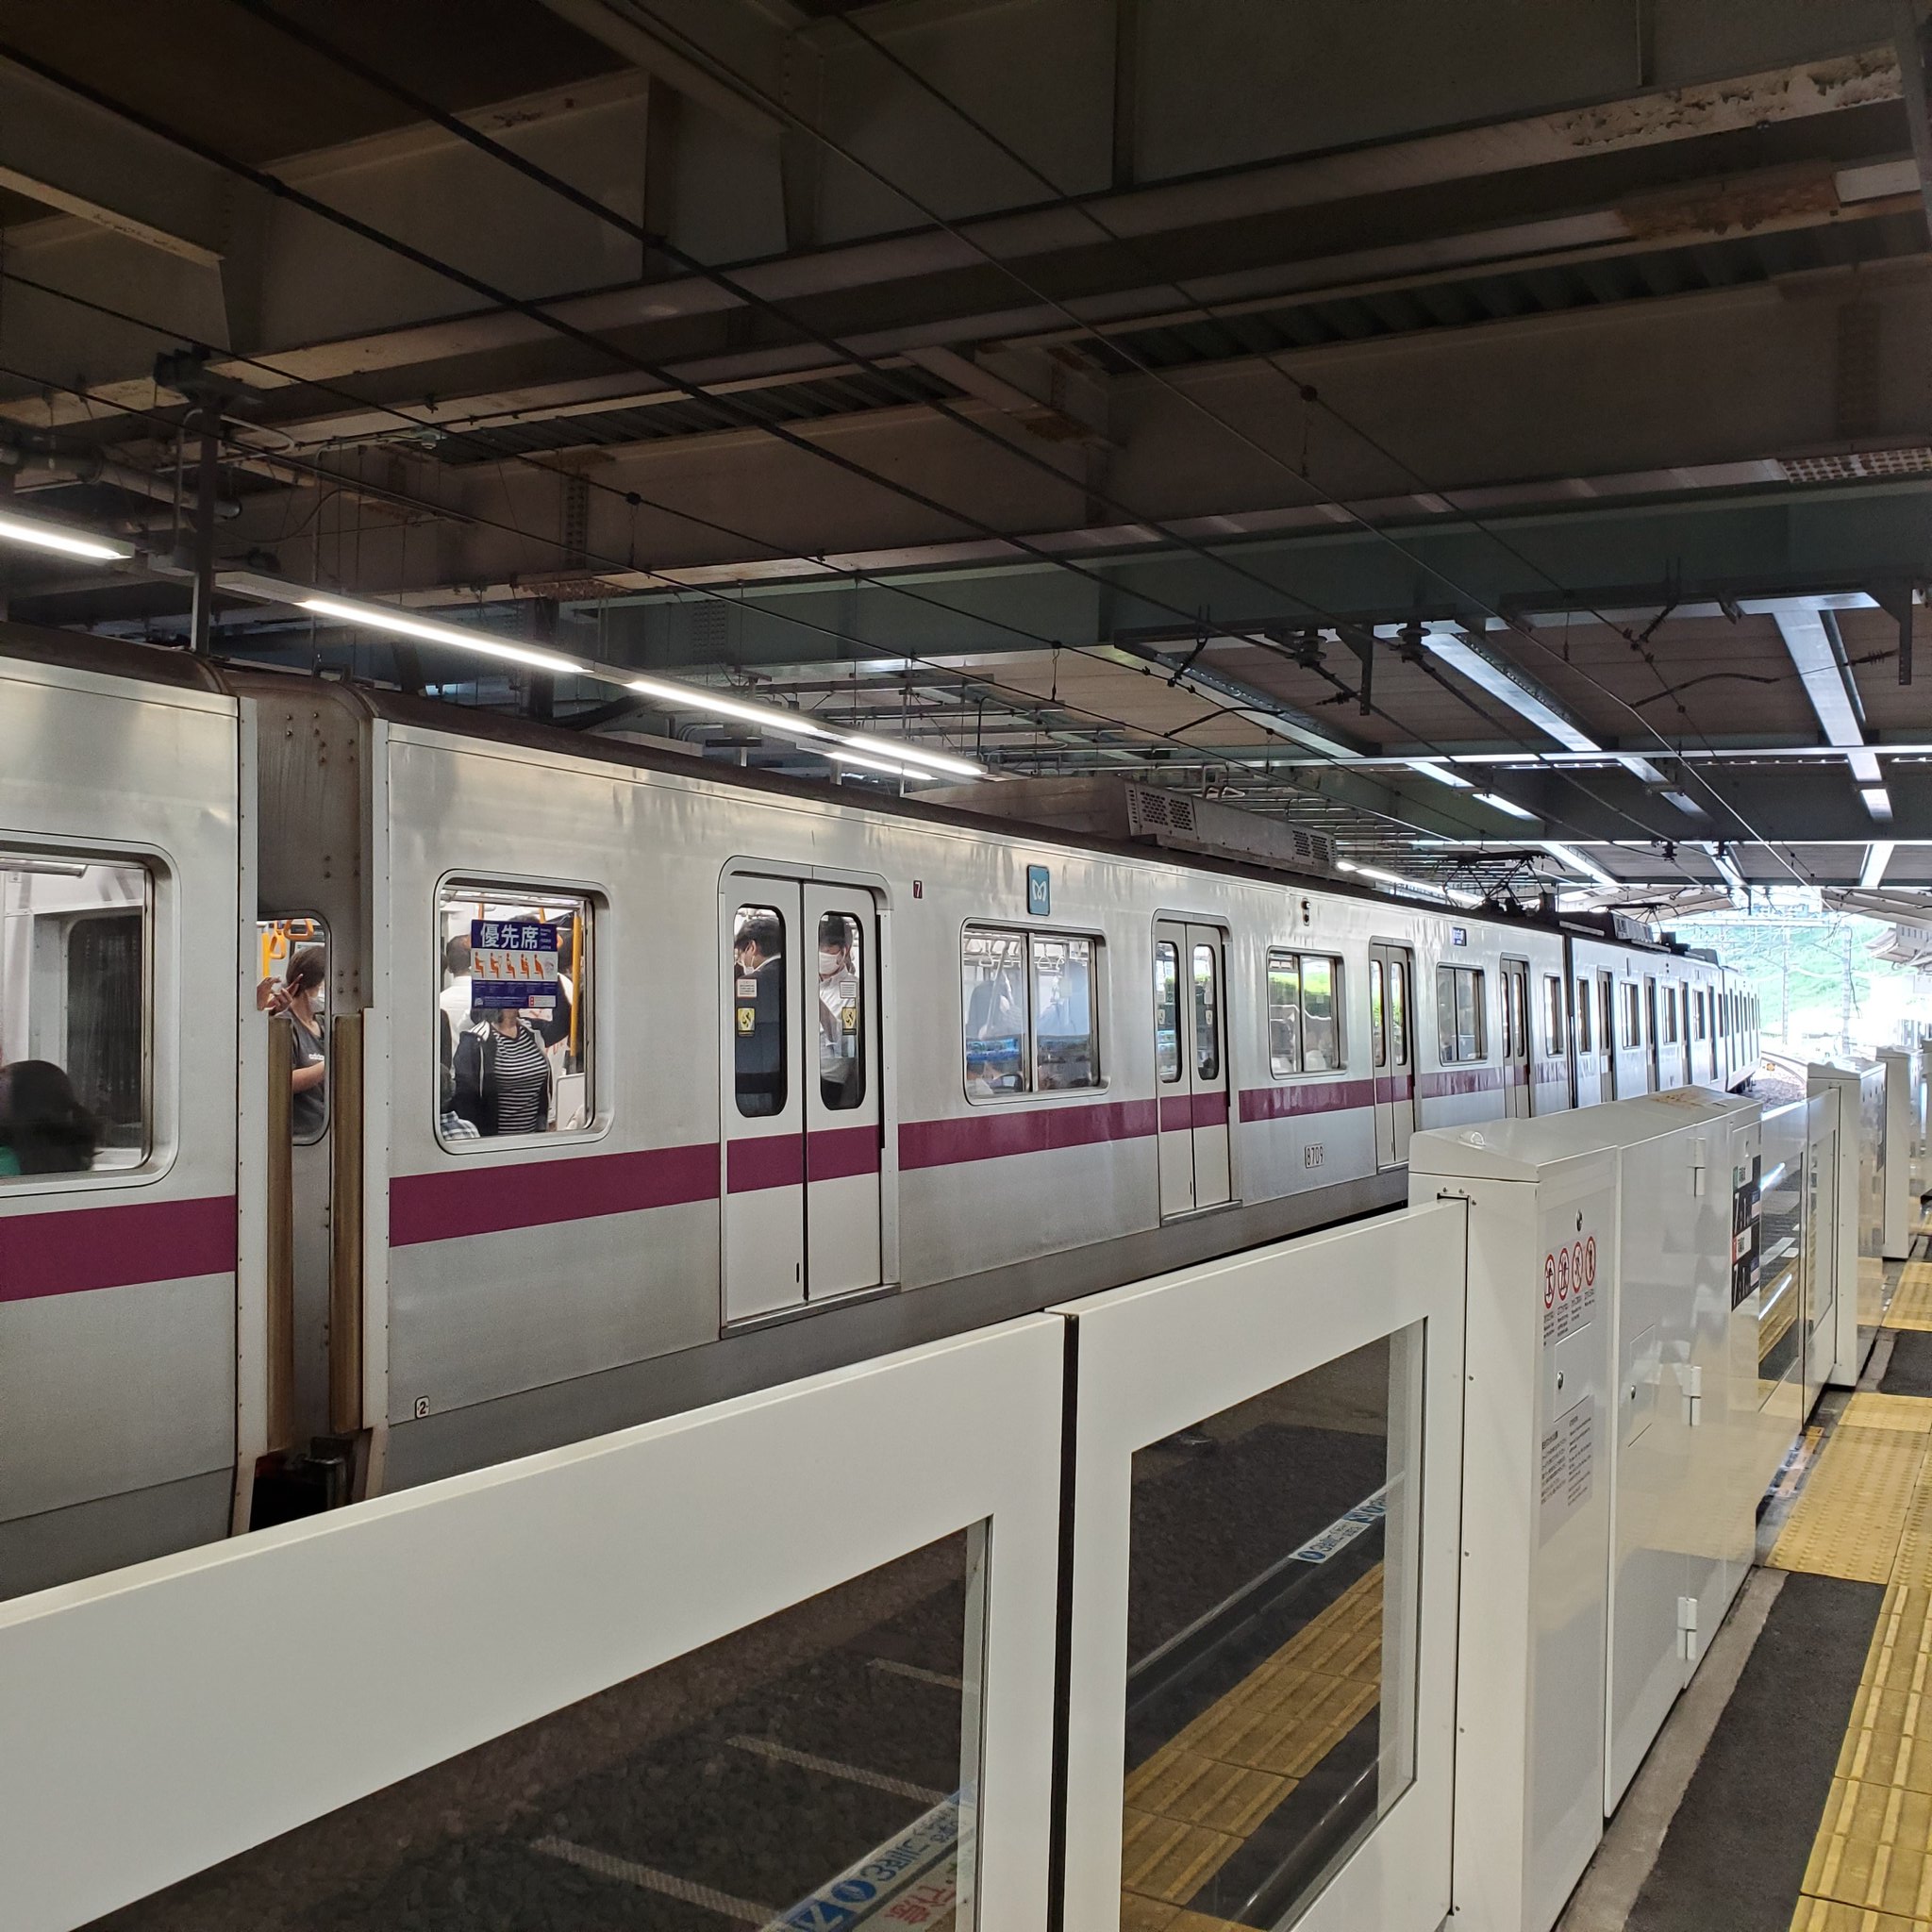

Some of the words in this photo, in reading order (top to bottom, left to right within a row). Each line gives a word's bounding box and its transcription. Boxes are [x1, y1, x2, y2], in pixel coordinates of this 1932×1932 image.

[480, 923, 539, 950] 優先席
[419, 1401, 426, 1415] 2
